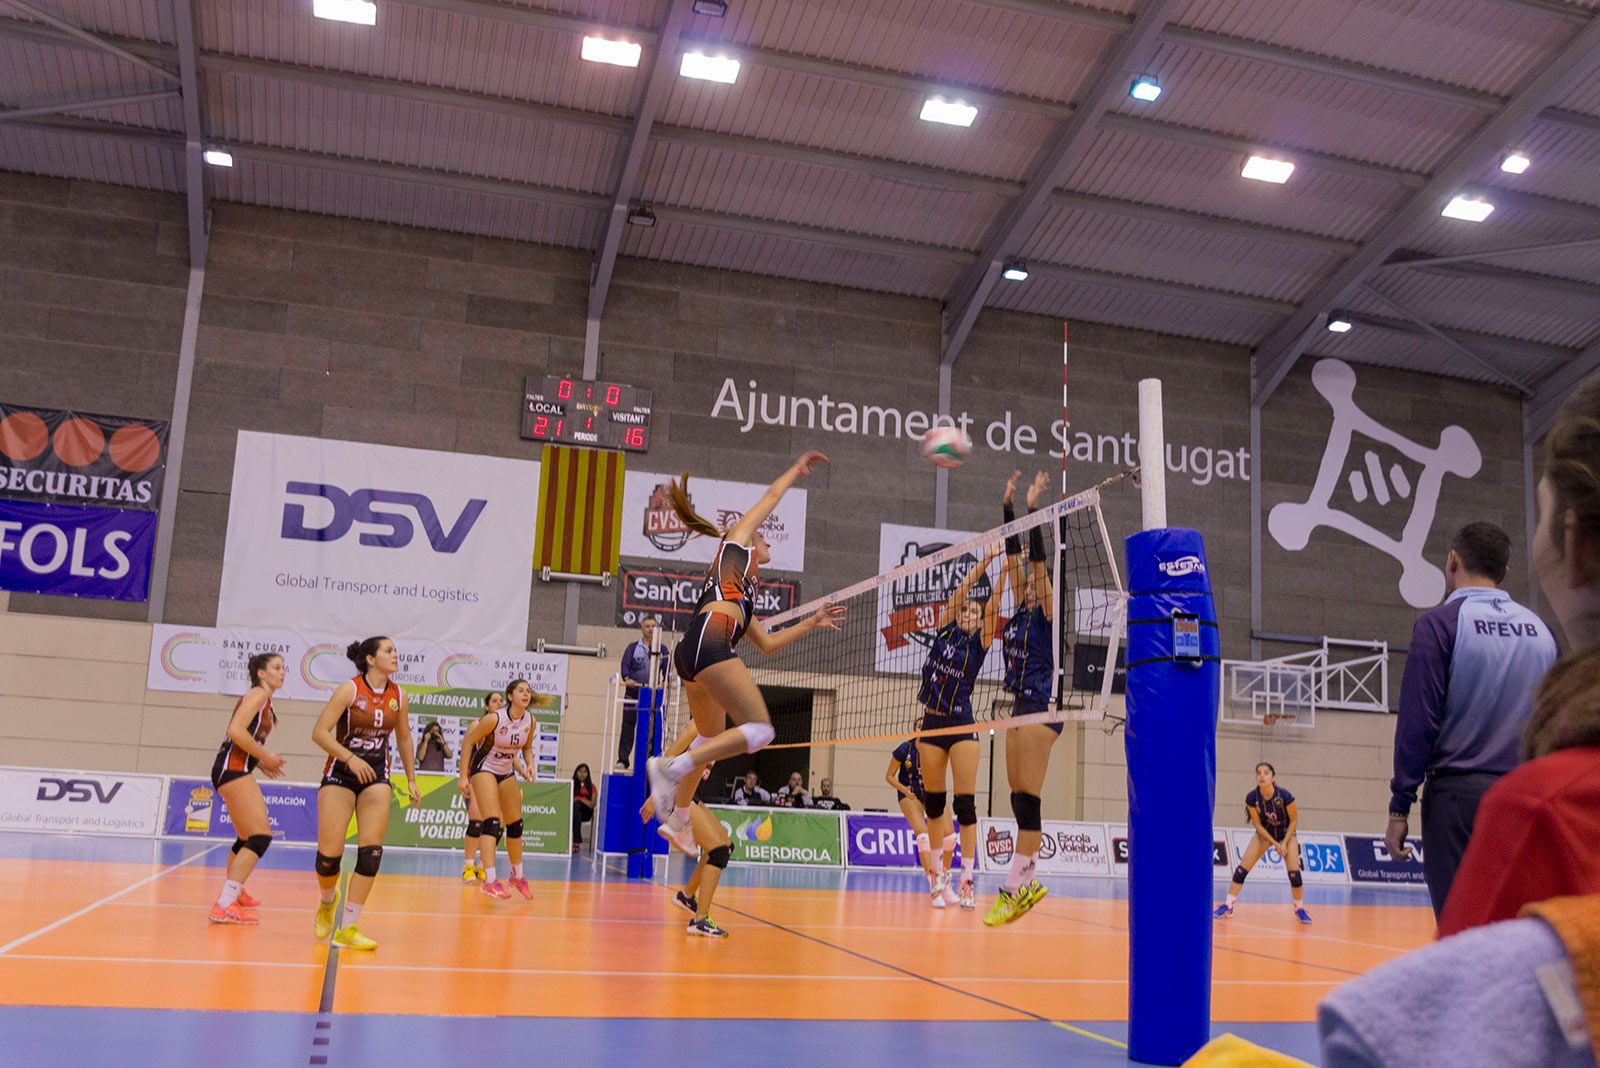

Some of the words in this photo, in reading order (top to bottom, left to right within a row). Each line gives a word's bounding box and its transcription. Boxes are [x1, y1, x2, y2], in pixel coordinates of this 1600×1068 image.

[558, 379, 573, 400] 0
[606, 385, 621, 406] 0
[529, 402, 564, 415] LOCAL
[585, 416, 593, 430] 1
[612, 411, 645, 425] VISITANT
[533, 415, 563, 439] 21
[711, 378, 974, 447] Ajuntament
[986, 411, 1038, 455] de
[1048, 419, 1138, 467] Sant
[1138, 441, 1251, 486] ugat
[625, 426, 645, 448] 16
[0, 466, 152, 503] SECURITAS
[281, 480, 488, 555] DSV
[648, 510, 685, 531] CVS
[274, 572, 320, 589] Global
[323, 576, 388, 602] Transport
[392, 583, 418, 598] and
[422, 584, 480, 605] Logistics
[1473, 619, 1538, 637] RFEVB
[222, 639, 252, 651] SANT
[255, 641, 291, 654] CUGAT
[398, 653, 426, 664] UGAT
[494, 660, 521, 670] SANT
[525, 662, 558, 672] CUGAT
[391, 672, 426, 684] UROPEA
[422, 693, 478, 709] IBERDROLA
[373, 708, 384, 728] 9
[349, 736, 384, 750] DSV
[510, 733, 520, 746] 15
[36, 777, 124, 805] DSV
[264, 795, 307, 806] DERACIÓN
[405, 808, 469, 825] IBERDROL
[521, 804, 556, 815] RDROLA
[0, 812, 32, 824] Global
[35, 814, 81, 828] Transport
[82, 816, 102, 827] and
[103, 817, 145, 830] Logistics
[419, 824, 468, 840] VOLEIB
[1056, 832, 1092, 845] Escola
[745, 845, 832, 862] IBERDROLA
[988, 838, 1012, 854] CVSC
[1059, 842, 1100, 855] Voleibol
[1372, 840, 1425, 863] DV
[1358, 868, 1379, 878] Global
[1379, 869, 1411, 881] Transport
[1412, 872, 1424, 880] and
